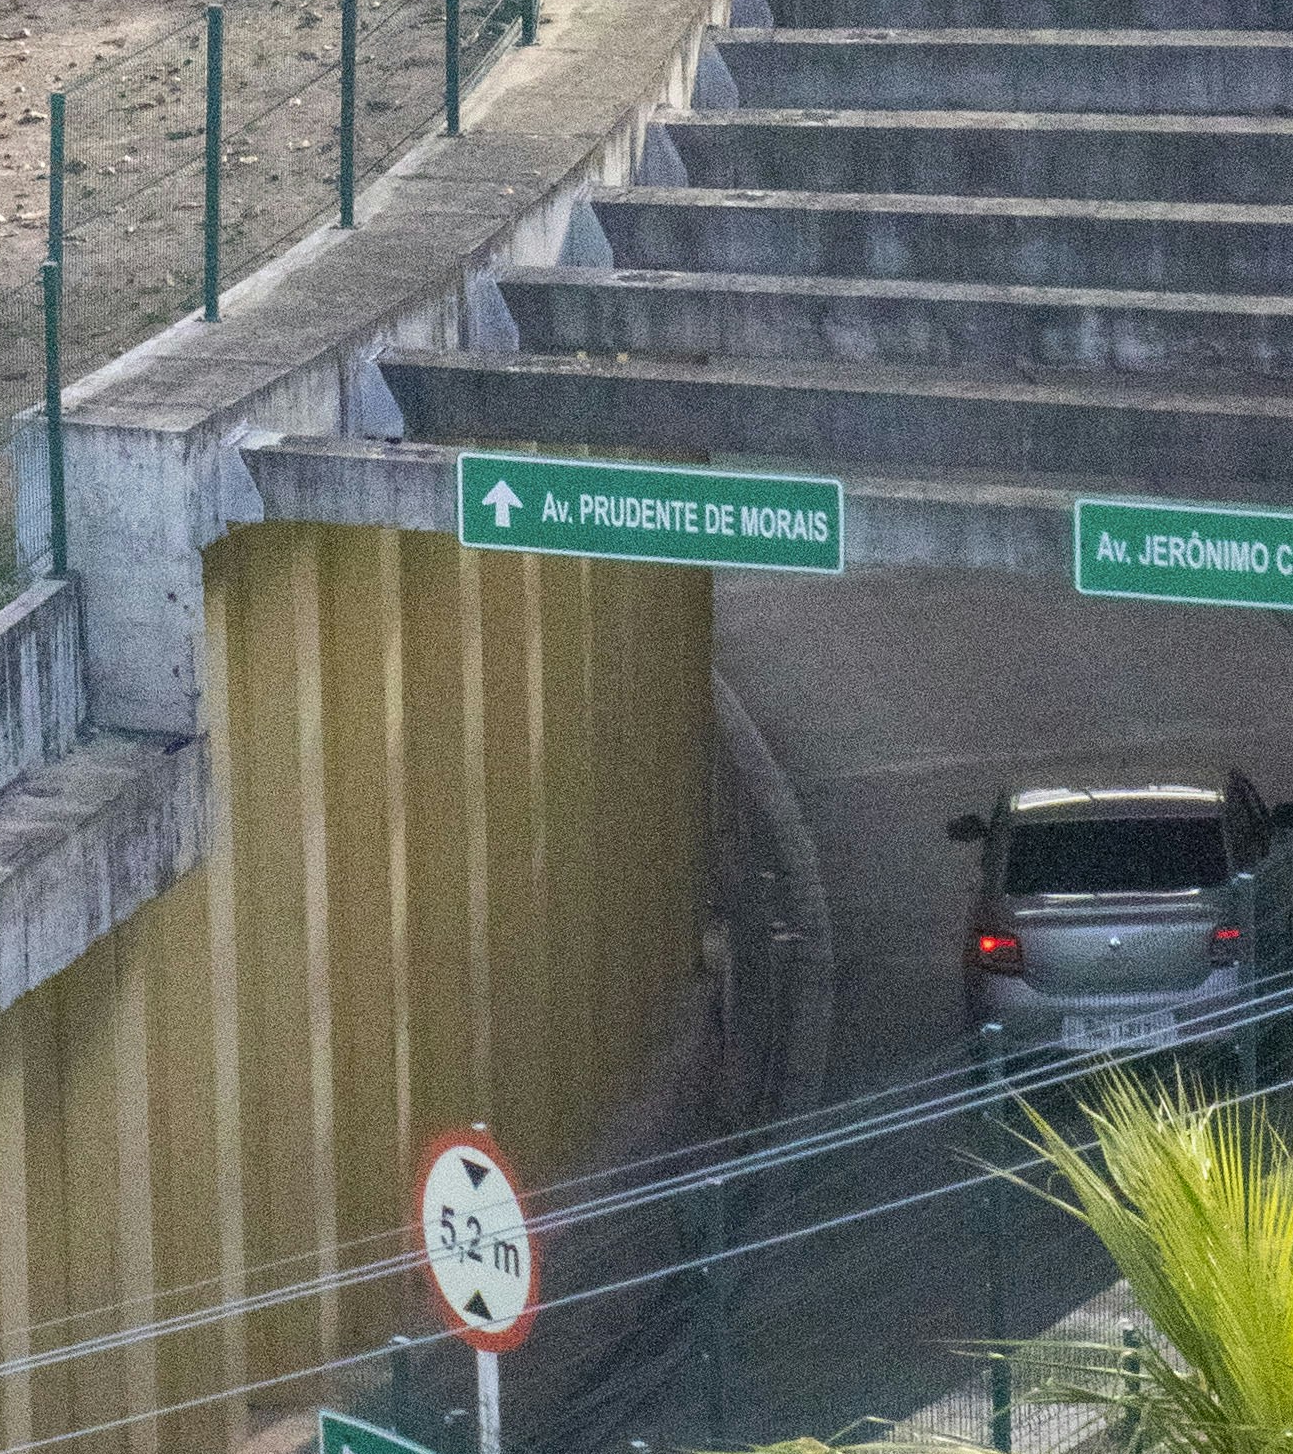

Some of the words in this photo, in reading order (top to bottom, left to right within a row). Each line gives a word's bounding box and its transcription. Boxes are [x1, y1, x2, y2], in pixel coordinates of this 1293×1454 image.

[541, 492, 574, 525] Av.
[579, 493, 699, 533] PRUDENTE
[705, 503, 736, 536] DE
[740, 506, 829, 543] MORAIS
[1096, 530, 1131, 565] Av.
[1138, 530, 1269, 573] JERÔNIMO
[440, 1205, 483, 1264] 5,2
[493, 1237, 520, 1278] m
